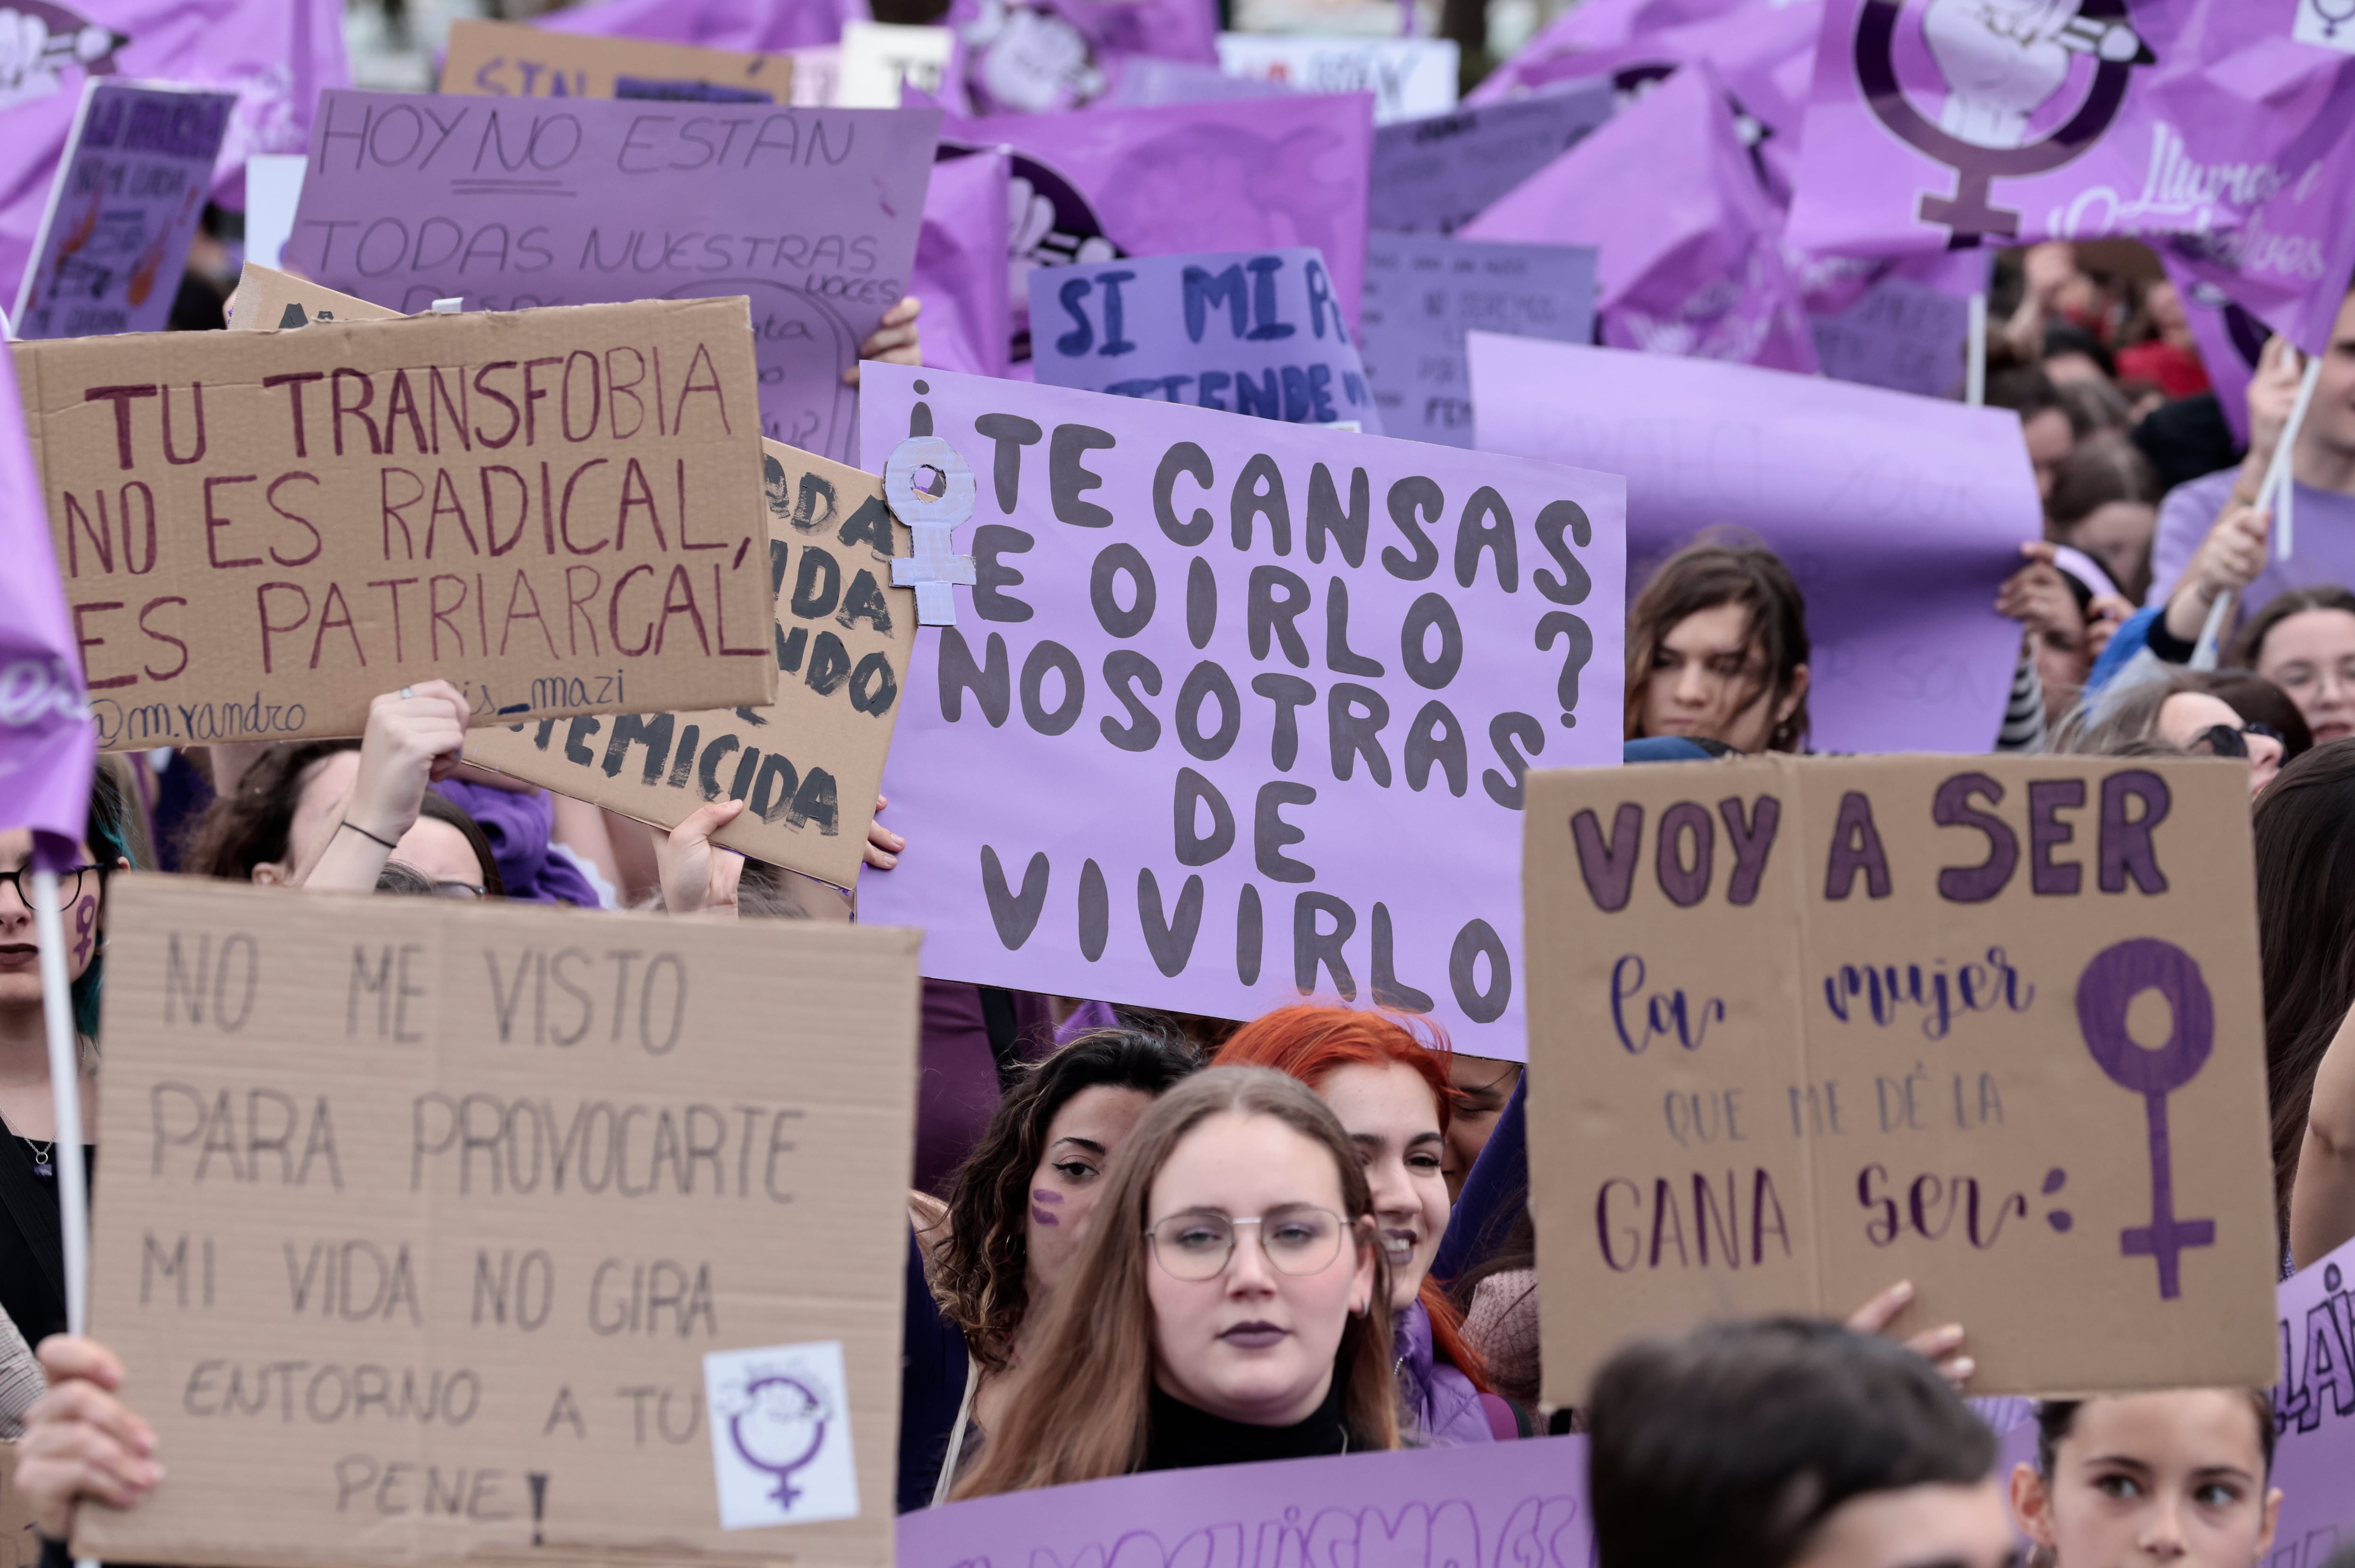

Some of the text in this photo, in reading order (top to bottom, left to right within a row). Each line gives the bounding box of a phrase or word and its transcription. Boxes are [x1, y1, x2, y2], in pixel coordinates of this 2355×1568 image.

[318, 97, 470, 175] HOY
[471, 107, 583, 172] NO
[303, 217, 879, 278] TODAS NUESTRAS
[1056, 269, 1138, 357] SI
[1181, 255, 1297, 344] MI
[84, 381, 206, 470] TU
[263, 343, 731, 457] TRANSFOBIA
[63, 457, 752, 577] NO ES RADICAL,
[1153, 441, 1592, 606] CANSAS
[72, 564, 771, 691] ES PATRIARCAL
[1090, 543, 1463, 691] OIRLO
[938, 626, 1545, 811] NOSOTRAS
[1174, 767, 1317, 883] DE
[1569, 767, 2173, 914] VOY A SER
[163, 931, 690, 1057] NO ME VISTO
[980, 845, 1512, 1024] VIVIRLO
[1610, 945, 2036, 1056] la mujer
[150, 1080, 808, 1205] PARA PROVOCARTE
[1663, 1087, 1748, 1149] QUE
[1788, 1080, 1847, 1138] ME
[1952, 1071, 2005, 1129] LA
[1595, 1167, 1792, 1274] GANA
[138, 1230, 719, 1340] MI VIDA NO GIRA
[181, 1357, 703, 1446] ENTORNO A TU
